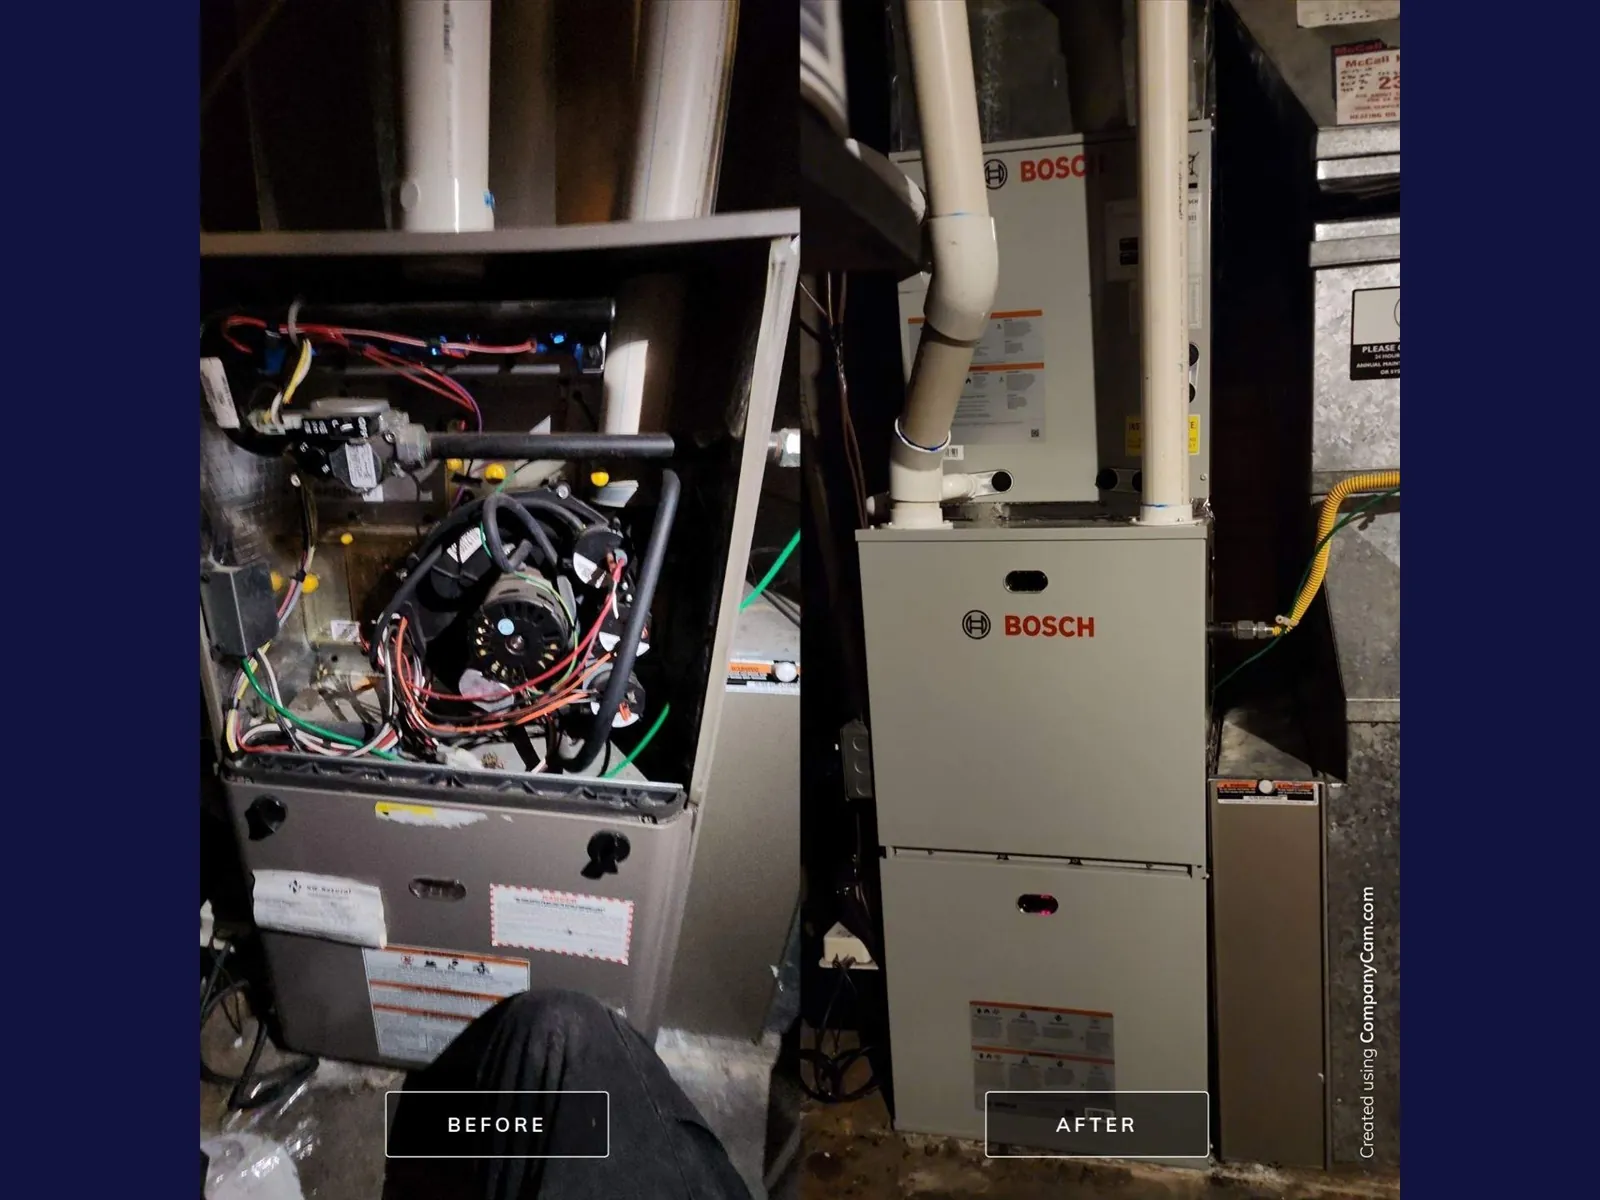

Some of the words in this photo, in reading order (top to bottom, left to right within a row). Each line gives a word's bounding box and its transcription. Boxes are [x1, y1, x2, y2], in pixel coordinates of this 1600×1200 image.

[1345, 55, 1389, 67] McCall
[1020, 154, 1106, 182] BOSCH
[1362, 344, 1396, 353] PLEASE
[1005, 615, 1094, 637] BOSCH
